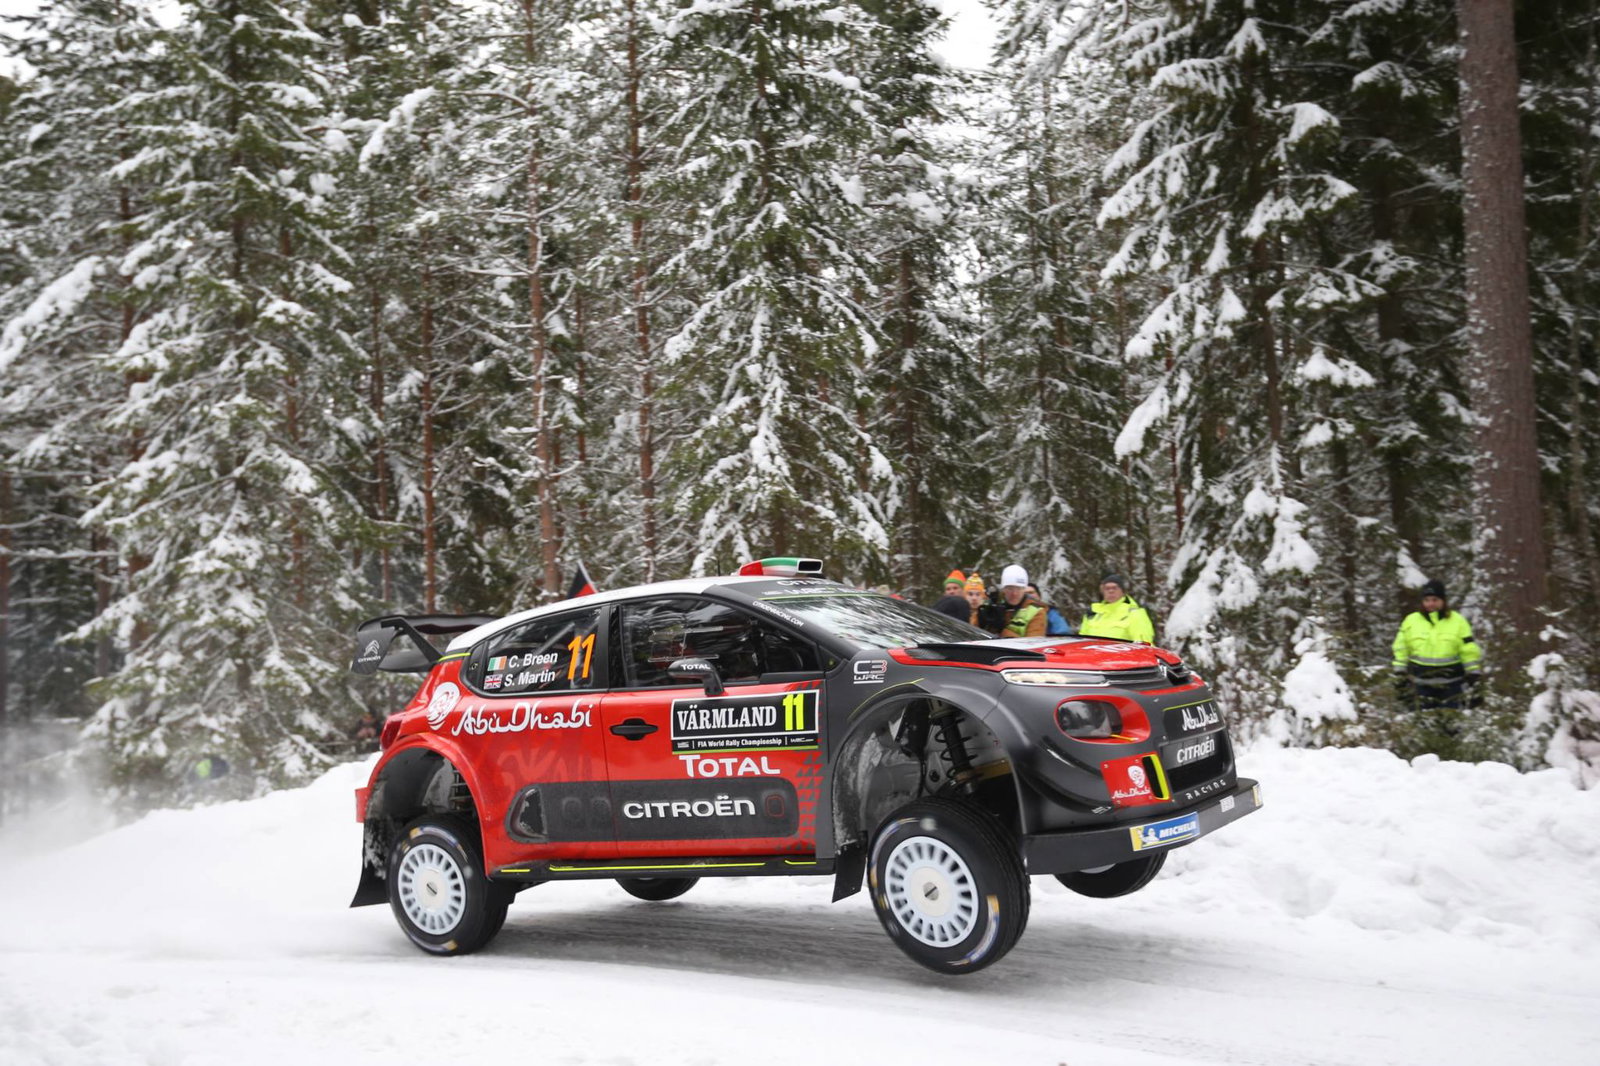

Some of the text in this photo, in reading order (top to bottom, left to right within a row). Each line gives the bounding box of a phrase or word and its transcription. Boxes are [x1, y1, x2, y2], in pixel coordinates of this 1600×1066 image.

[508, 652, 559, 668] C. Breen
[567, 633, 596, 680] 11
[681, 663, 711, 671] TOTAL
[853, 659, 888, 675] C3
[504, 669, 556, 688] S. Martin
[853, 673, 886, 681] WRC
[677, 704, 777, 731] VÄRMLAND
[782, 693, 804, 731] 11
[697, 740, 707, 748] FIA
[708, 738, 725, 748] World
[726, 738, 740, 748] Rally
[741, 735, 782, 747] Championship
[1176, 736, 1215, 764] CITROËN
[678, 754, 781, 778] TOTAL
[622, 794, 756, 820] CITROËN
